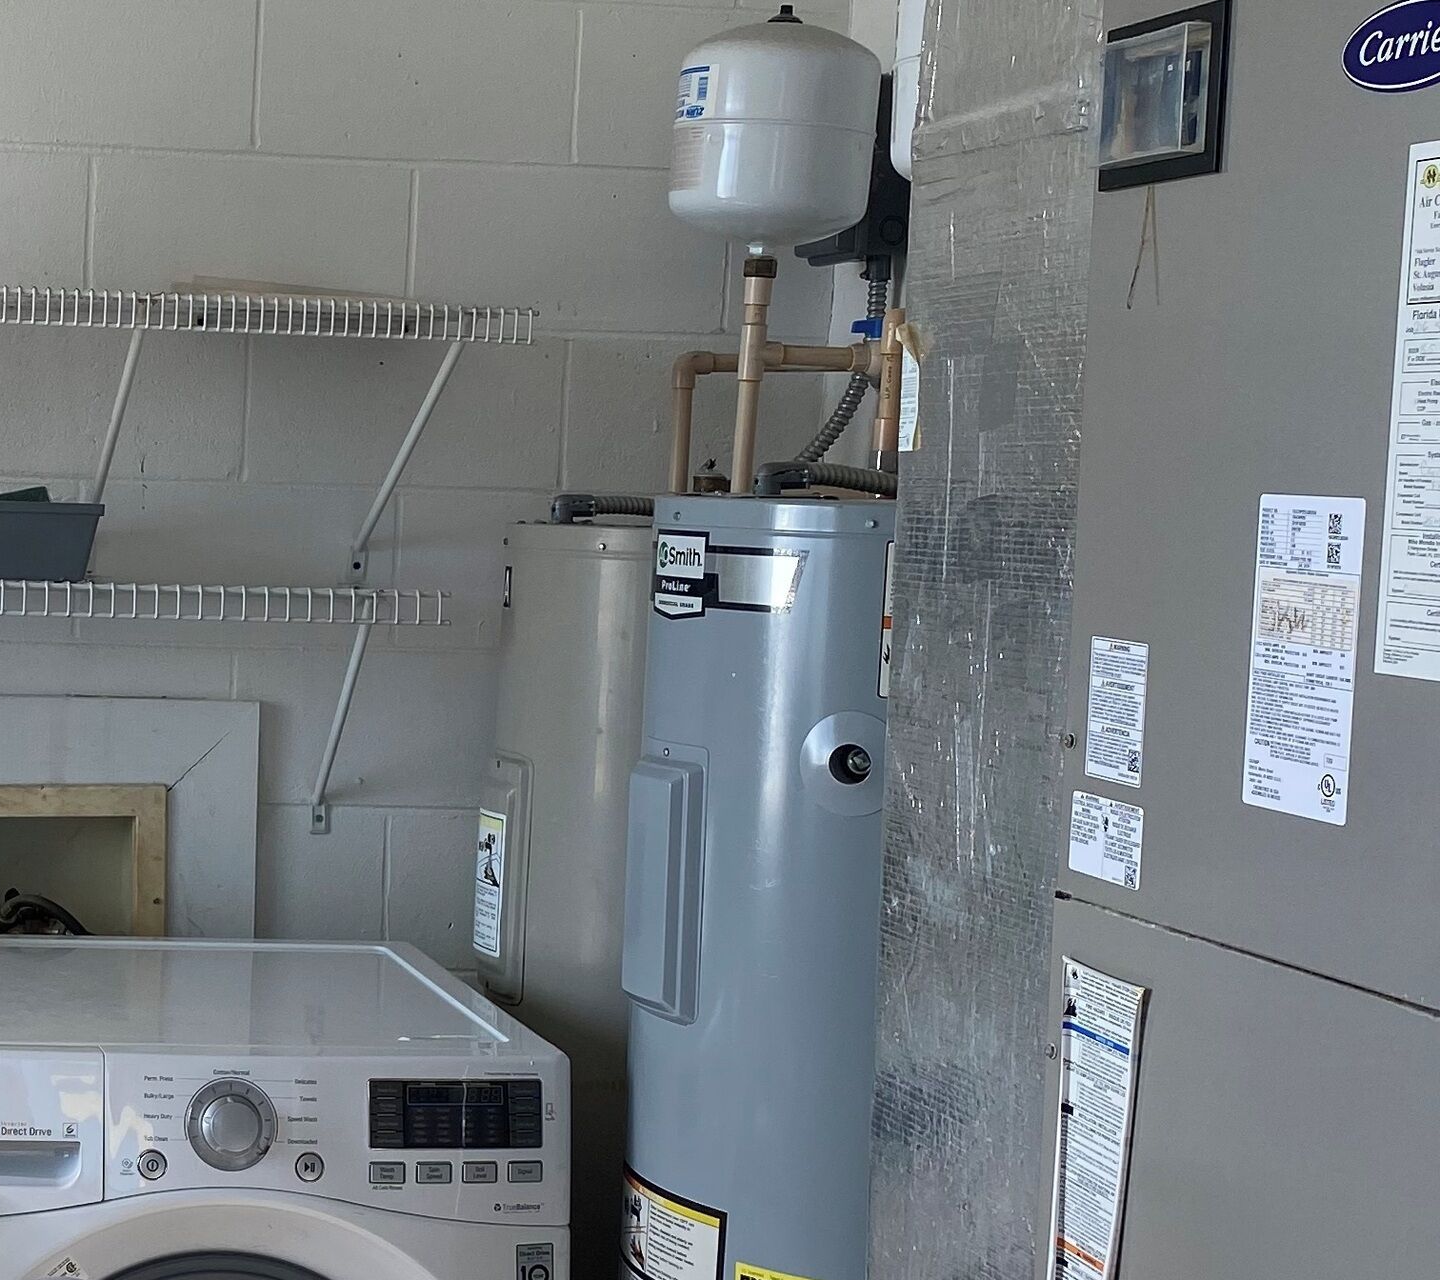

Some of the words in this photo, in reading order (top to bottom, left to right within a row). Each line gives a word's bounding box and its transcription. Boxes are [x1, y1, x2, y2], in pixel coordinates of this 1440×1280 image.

[1412, 308, 1437, 320] Florida
[669, 546, 702, 567] Smith
[1, 1126, 27, 1136] Direct
[29, 1127, 52, 1136] Drive
